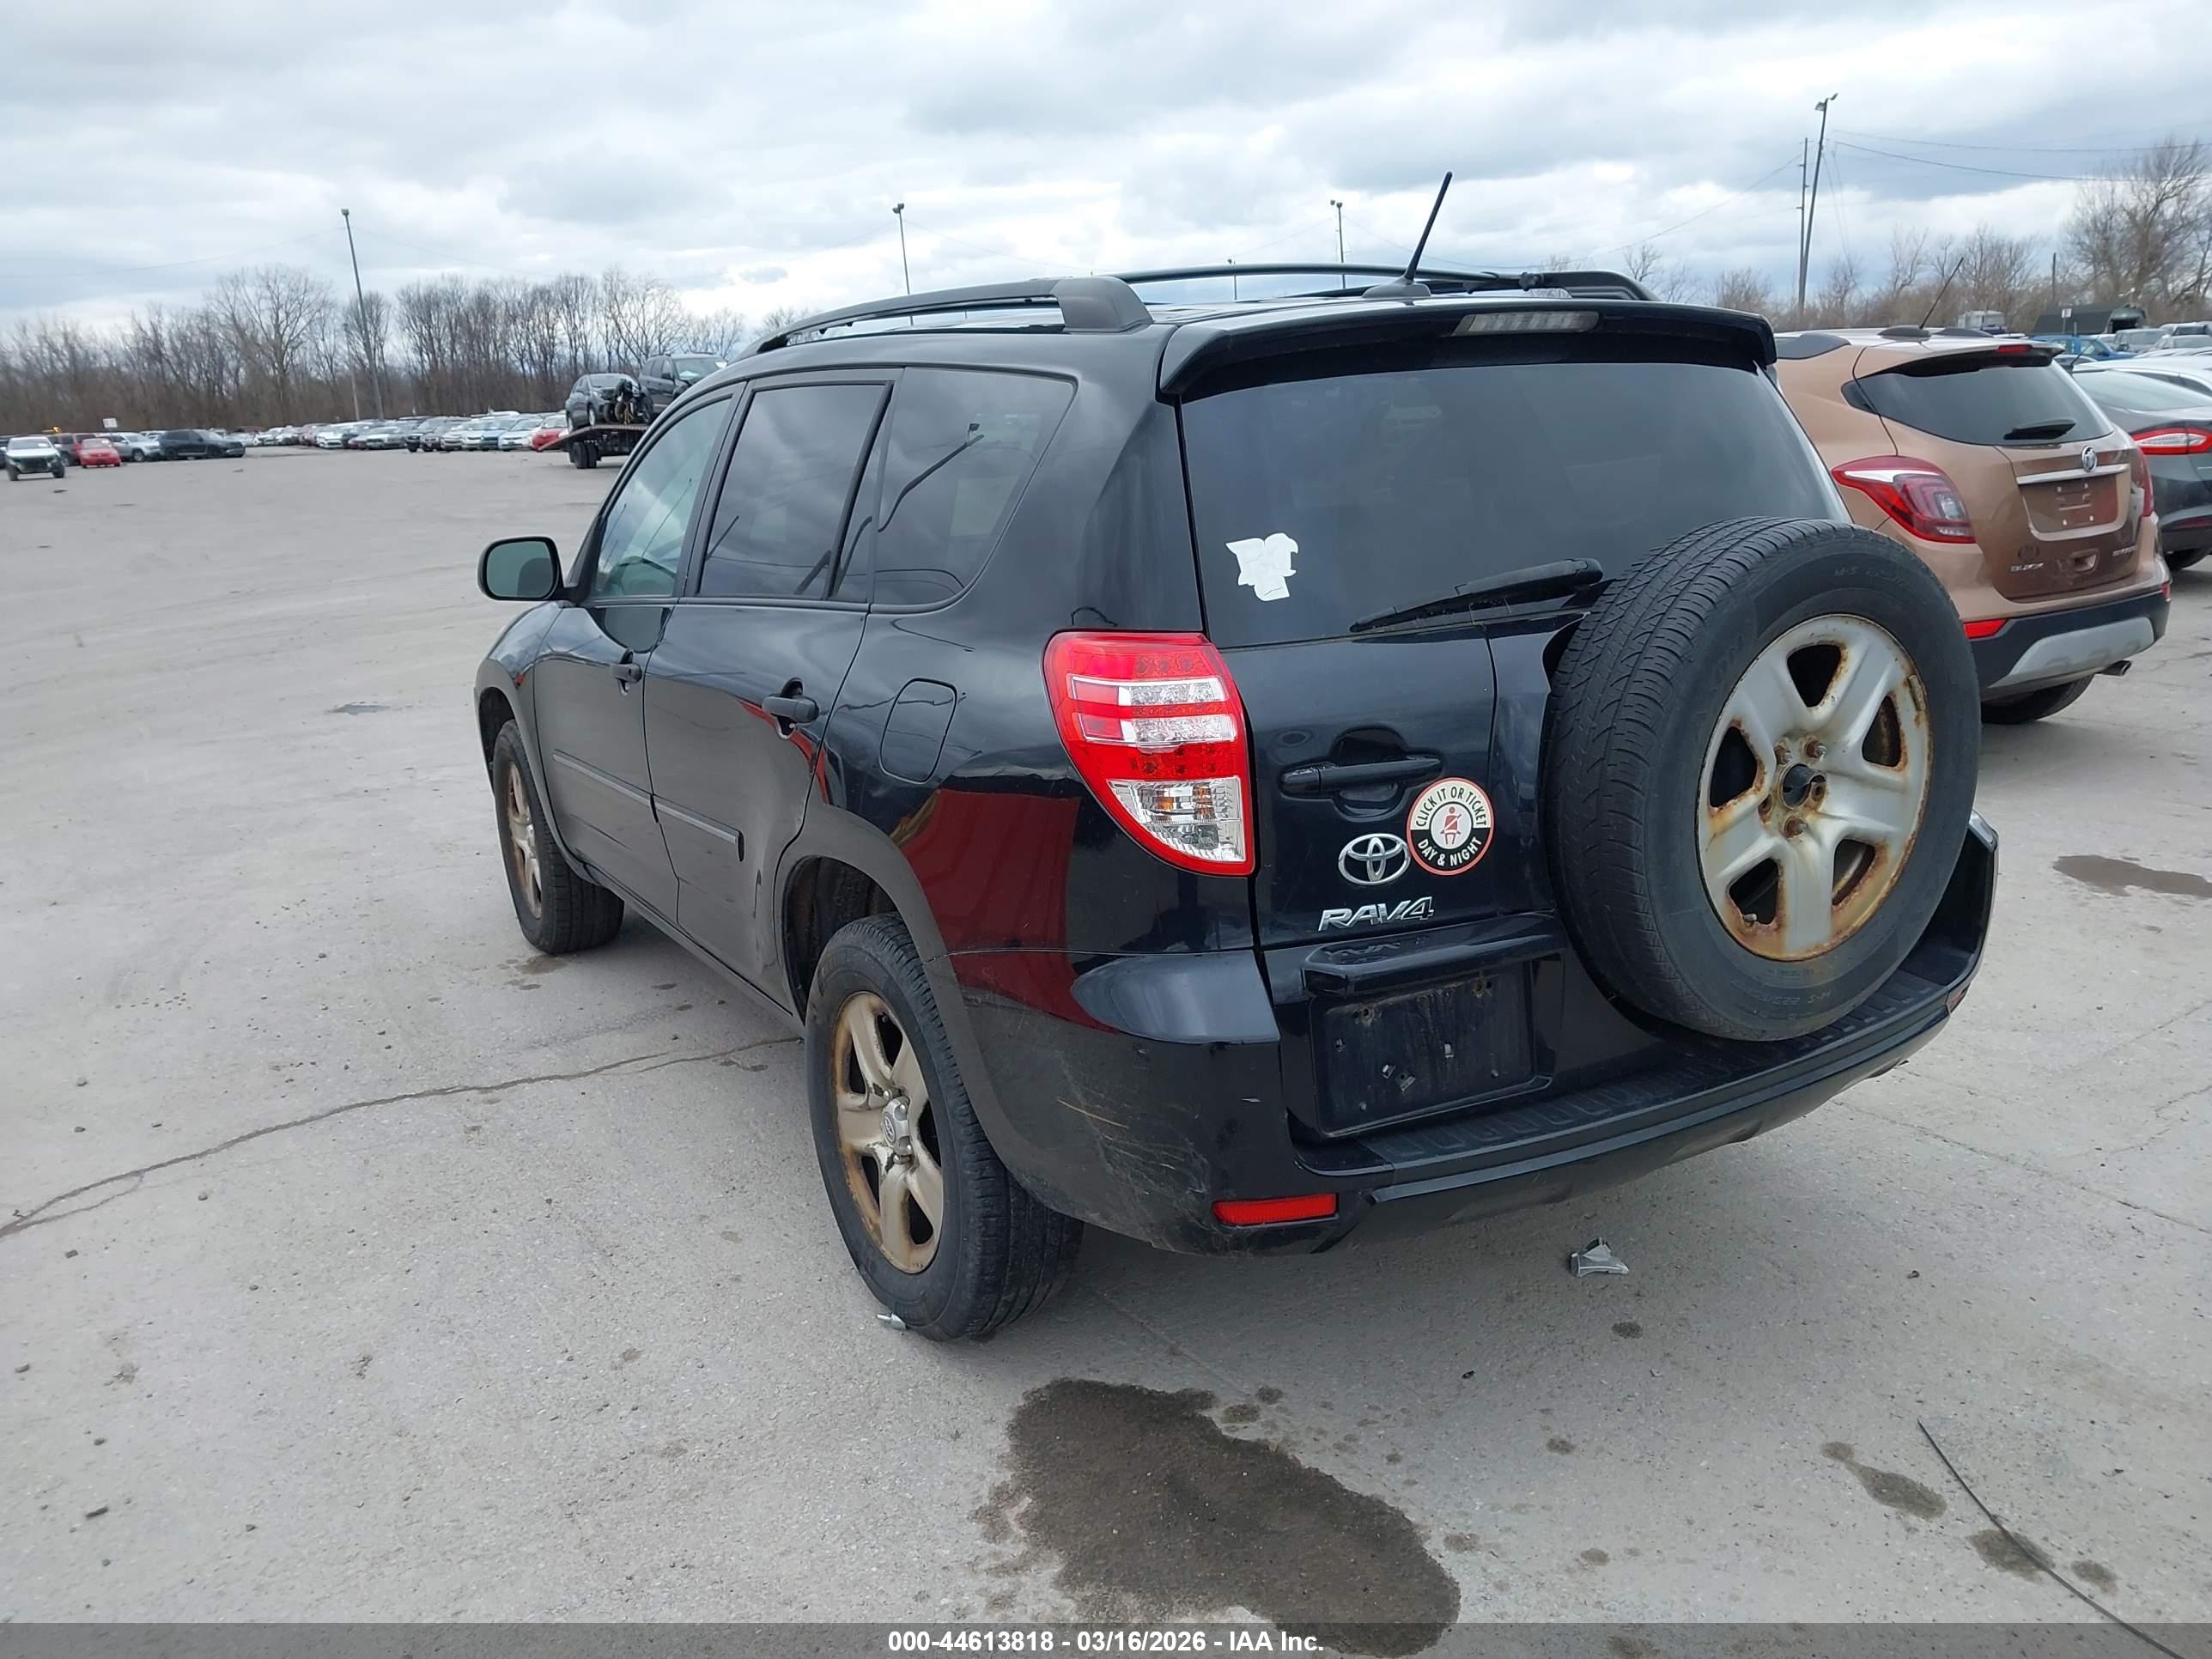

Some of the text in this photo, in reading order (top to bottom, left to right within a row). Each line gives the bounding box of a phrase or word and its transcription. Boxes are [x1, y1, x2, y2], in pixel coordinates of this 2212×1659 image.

[1416, 786, 1487, 827] CLICK IT OR TICKET
[1418, 836, 1482, 866] DAY & NIGHT
[1317, 896, 1435, 932] RAV4
